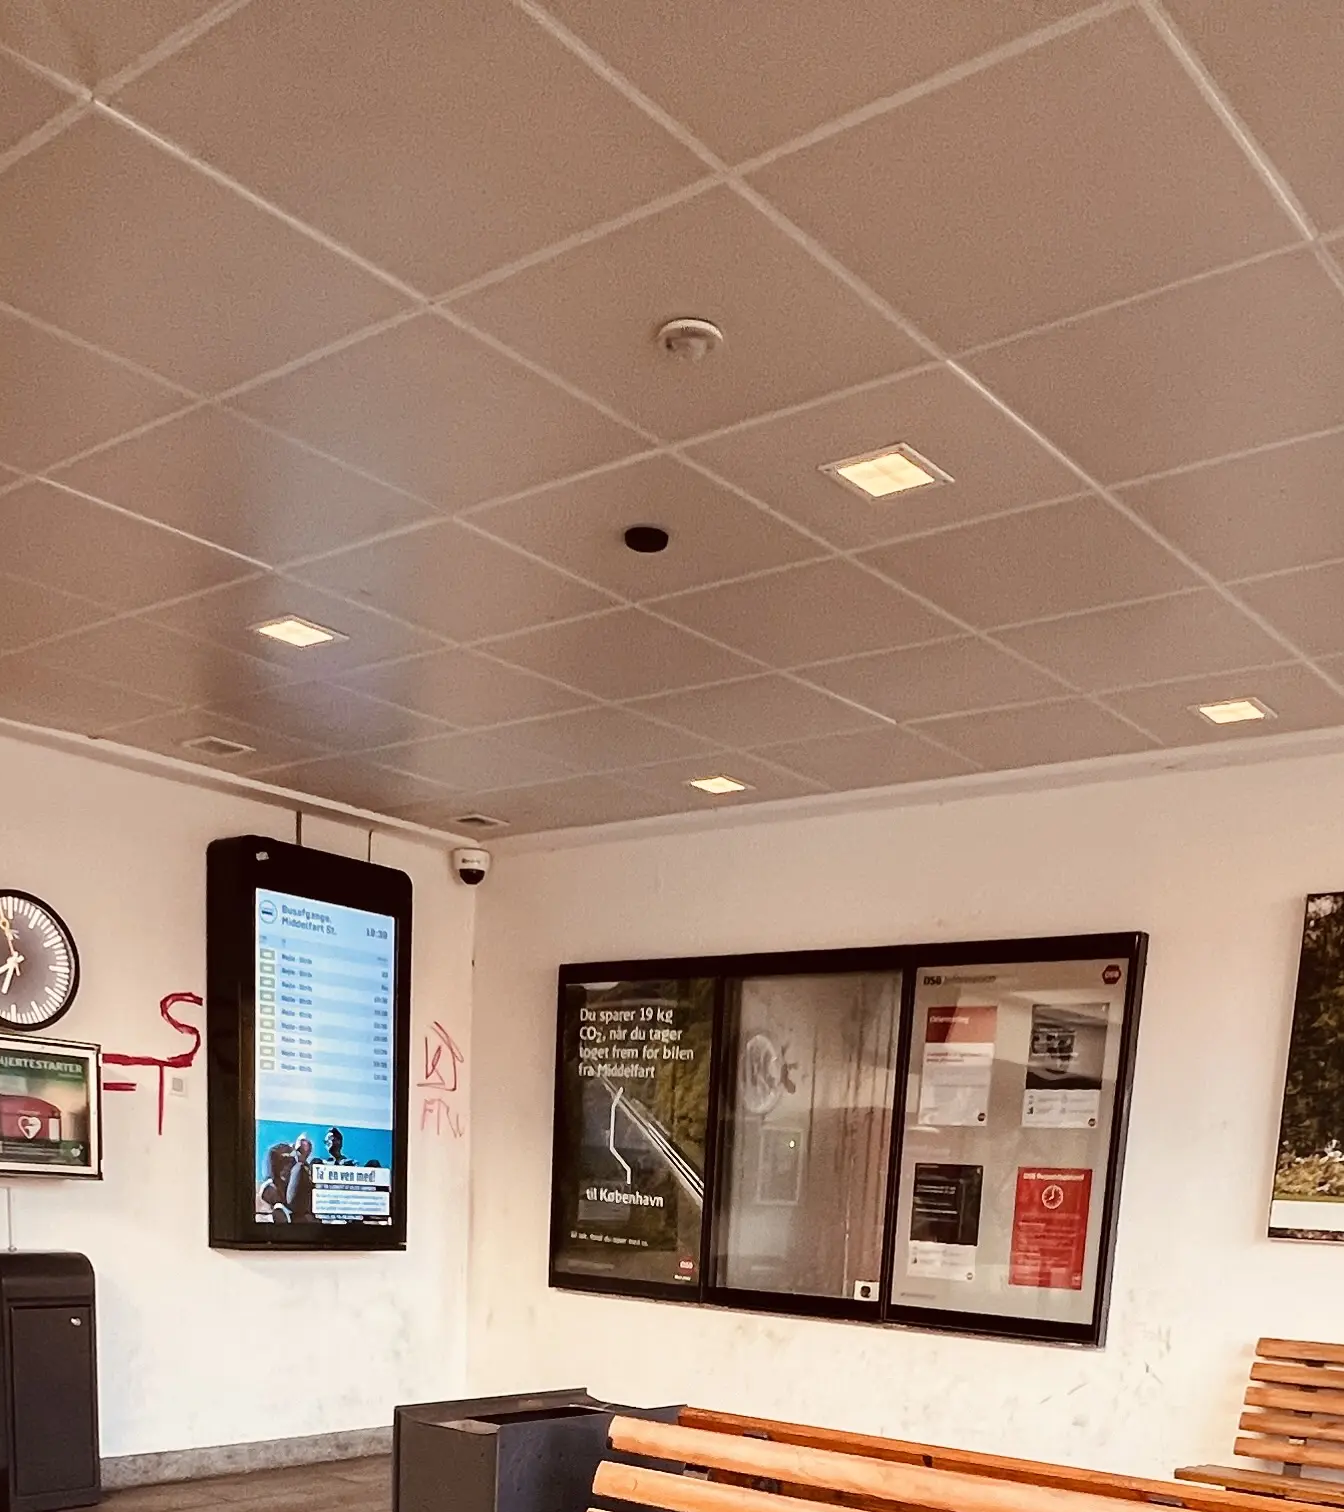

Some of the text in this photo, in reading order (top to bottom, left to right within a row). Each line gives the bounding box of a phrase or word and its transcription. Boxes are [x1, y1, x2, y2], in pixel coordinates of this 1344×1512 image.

[580, 1007, 673, 1024] Du sparer 19 kg
[609, 1026, 627, 1041] når
[630, 1026, 646, 1041] du
[649, 1028, 683, 1043] tager
[579, 1042, 694, 1060] toget frem for bilen
[578, 1062, 655, 1078] fra Middelfart
[315, 1166, 376, 1182] Ta' en ven med!
[586, 1187, 664, 1208] til København
